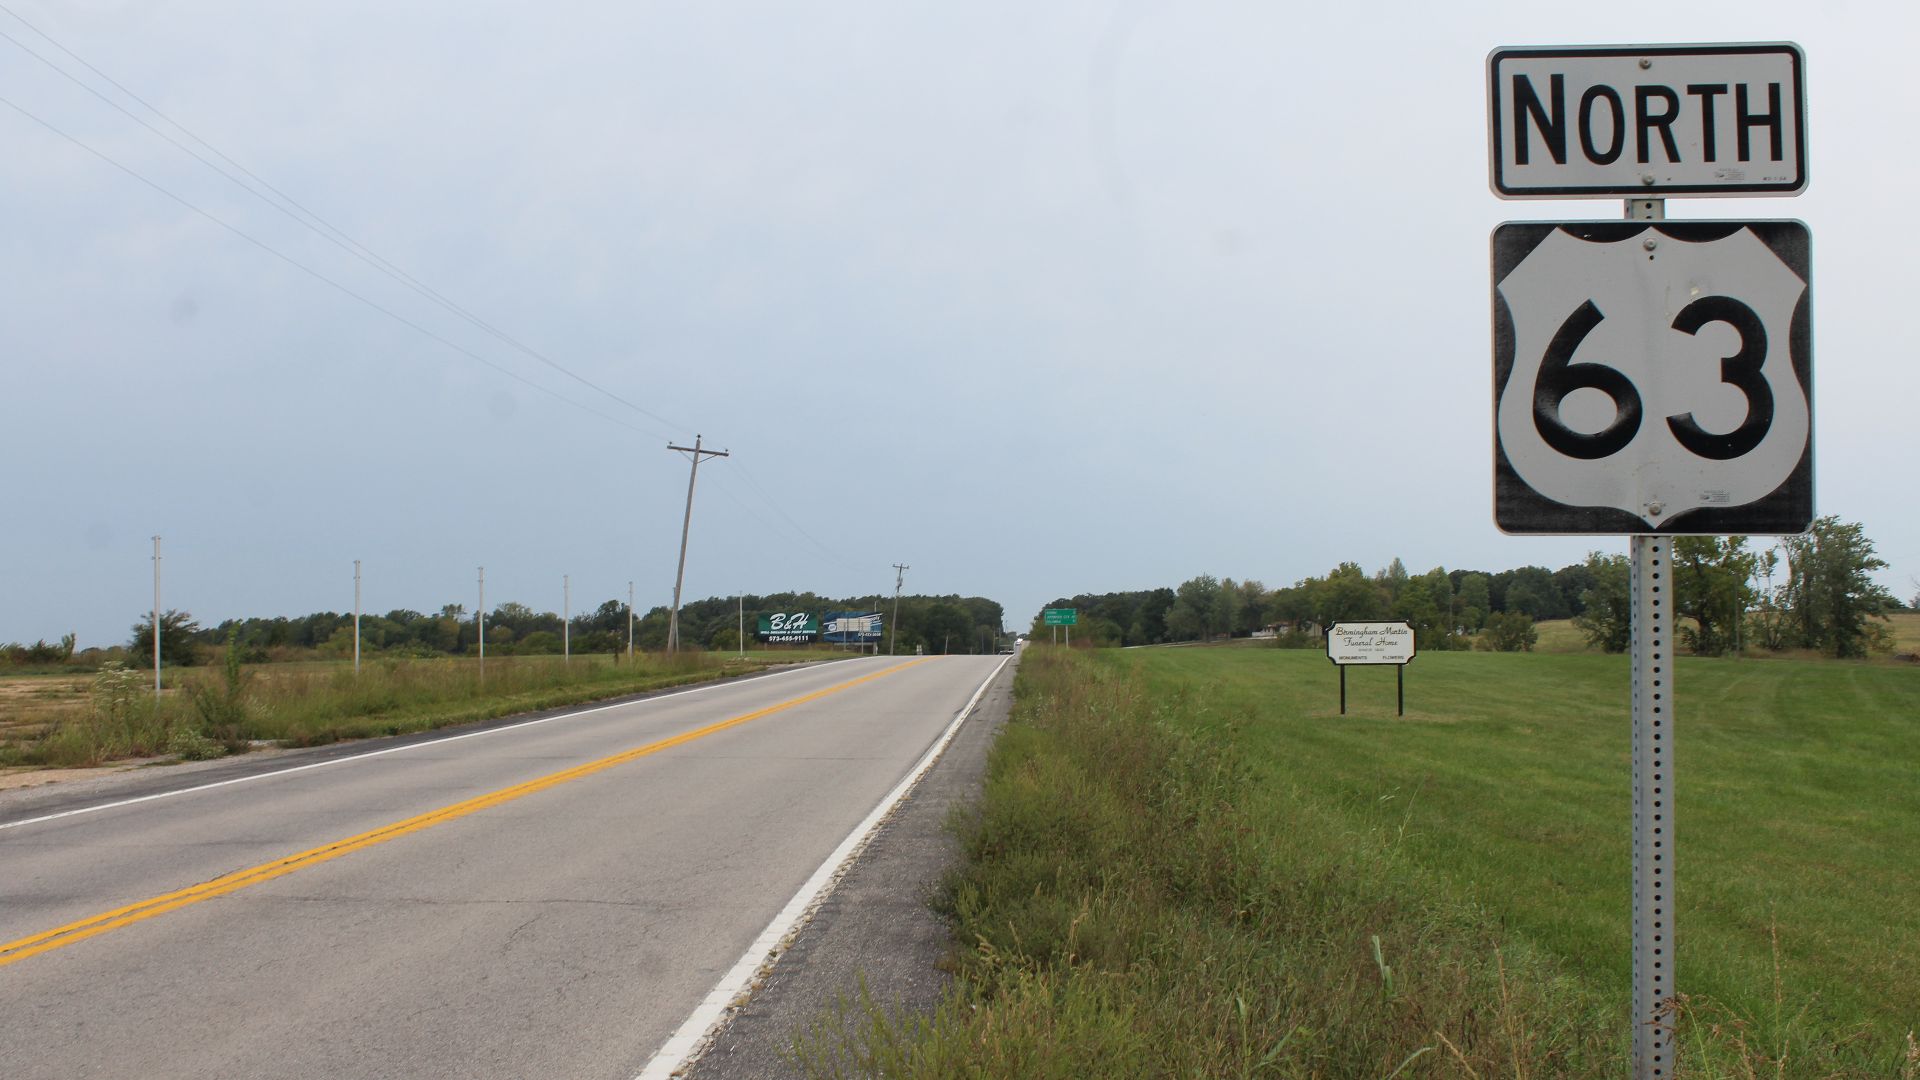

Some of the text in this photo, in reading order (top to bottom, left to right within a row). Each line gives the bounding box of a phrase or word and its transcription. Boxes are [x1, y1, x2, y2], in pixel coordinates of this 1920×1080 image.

[1513, 73, 1783, 166] NORTH
[1532, 295, 1775, 460] 63
[770, 613, 810, 630] B&H
[1345, 637, 1398, 646] Funeral Home
